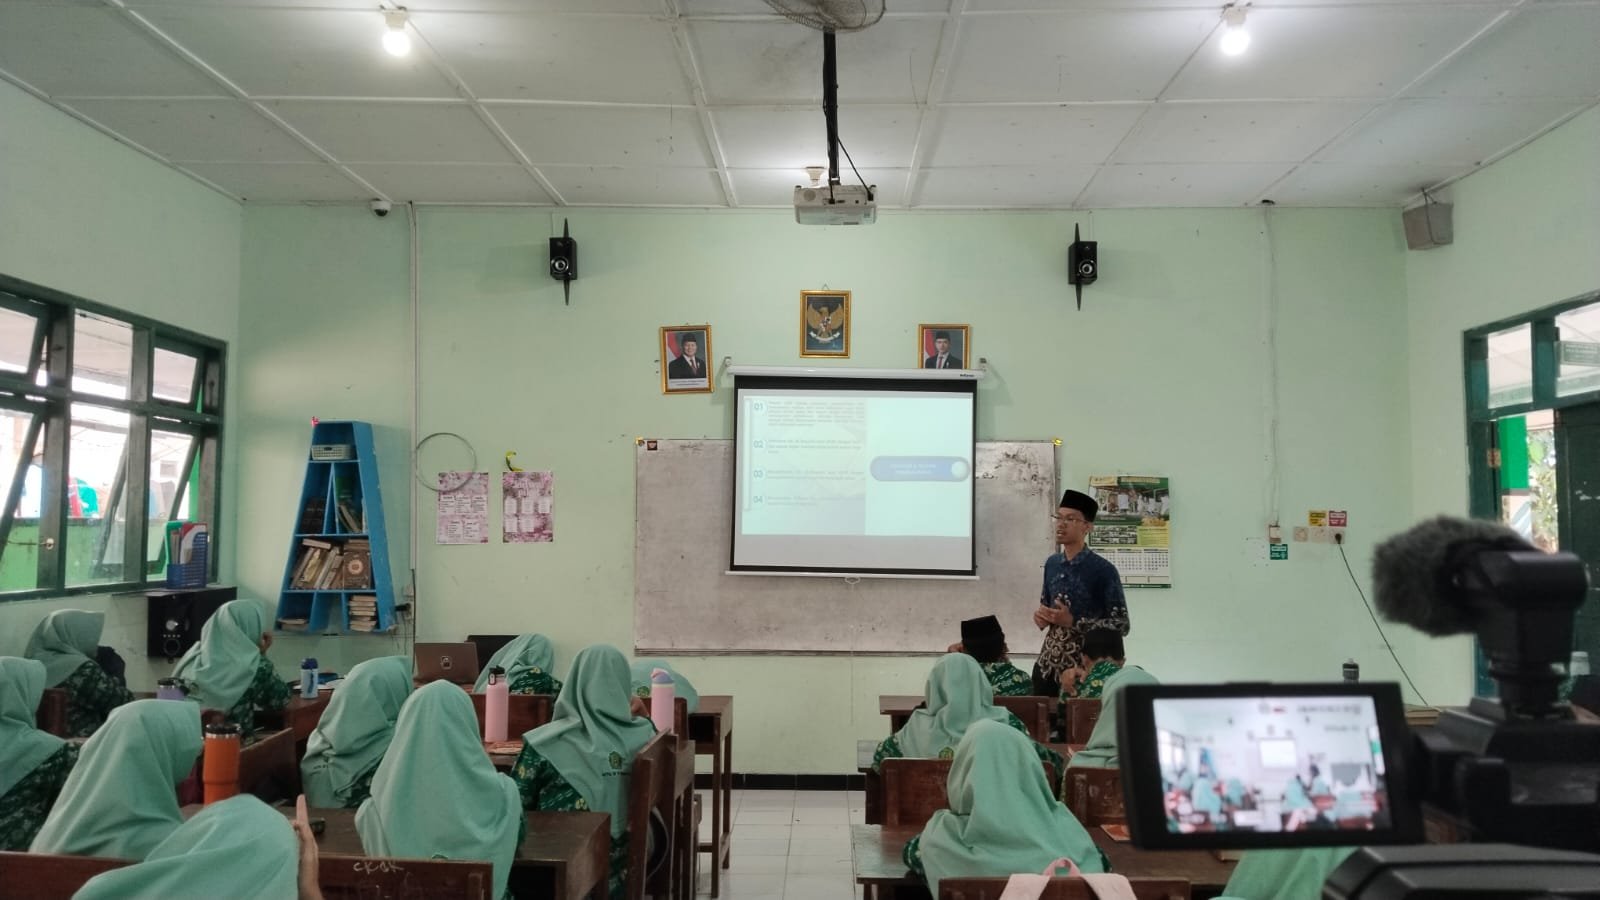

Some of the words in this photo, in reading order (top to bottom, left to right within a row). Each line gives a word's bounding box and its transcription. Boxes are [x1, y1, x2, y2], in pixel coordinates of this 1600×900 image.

[753, 402, 763, 411] 01
[753, 440, 763, 449] 02
[753, 470, 763, 478] 03
[753, 496, 763, 504] 04
